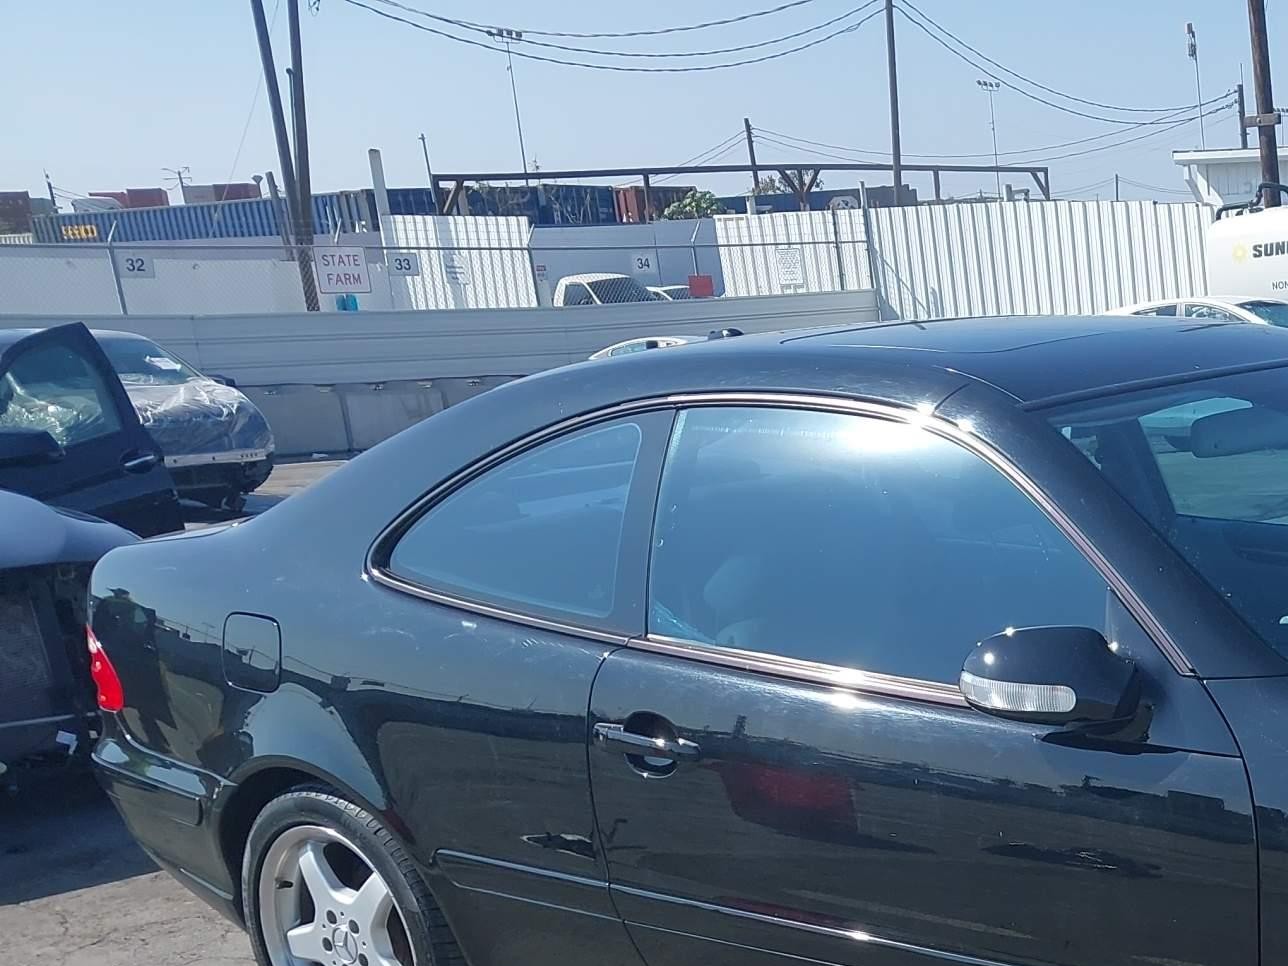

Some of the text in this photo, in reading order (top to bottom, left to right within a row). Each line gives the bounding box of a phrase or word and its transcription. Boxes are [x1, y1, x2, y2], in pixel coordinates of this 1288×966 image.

[125, 258, 146, 272] 32
[321, 254, 361, 267] STATE
[394, 258, 412, 271] 33
[636, 257, 651, 270] 34
[326, 273, 362, 286] FARM
